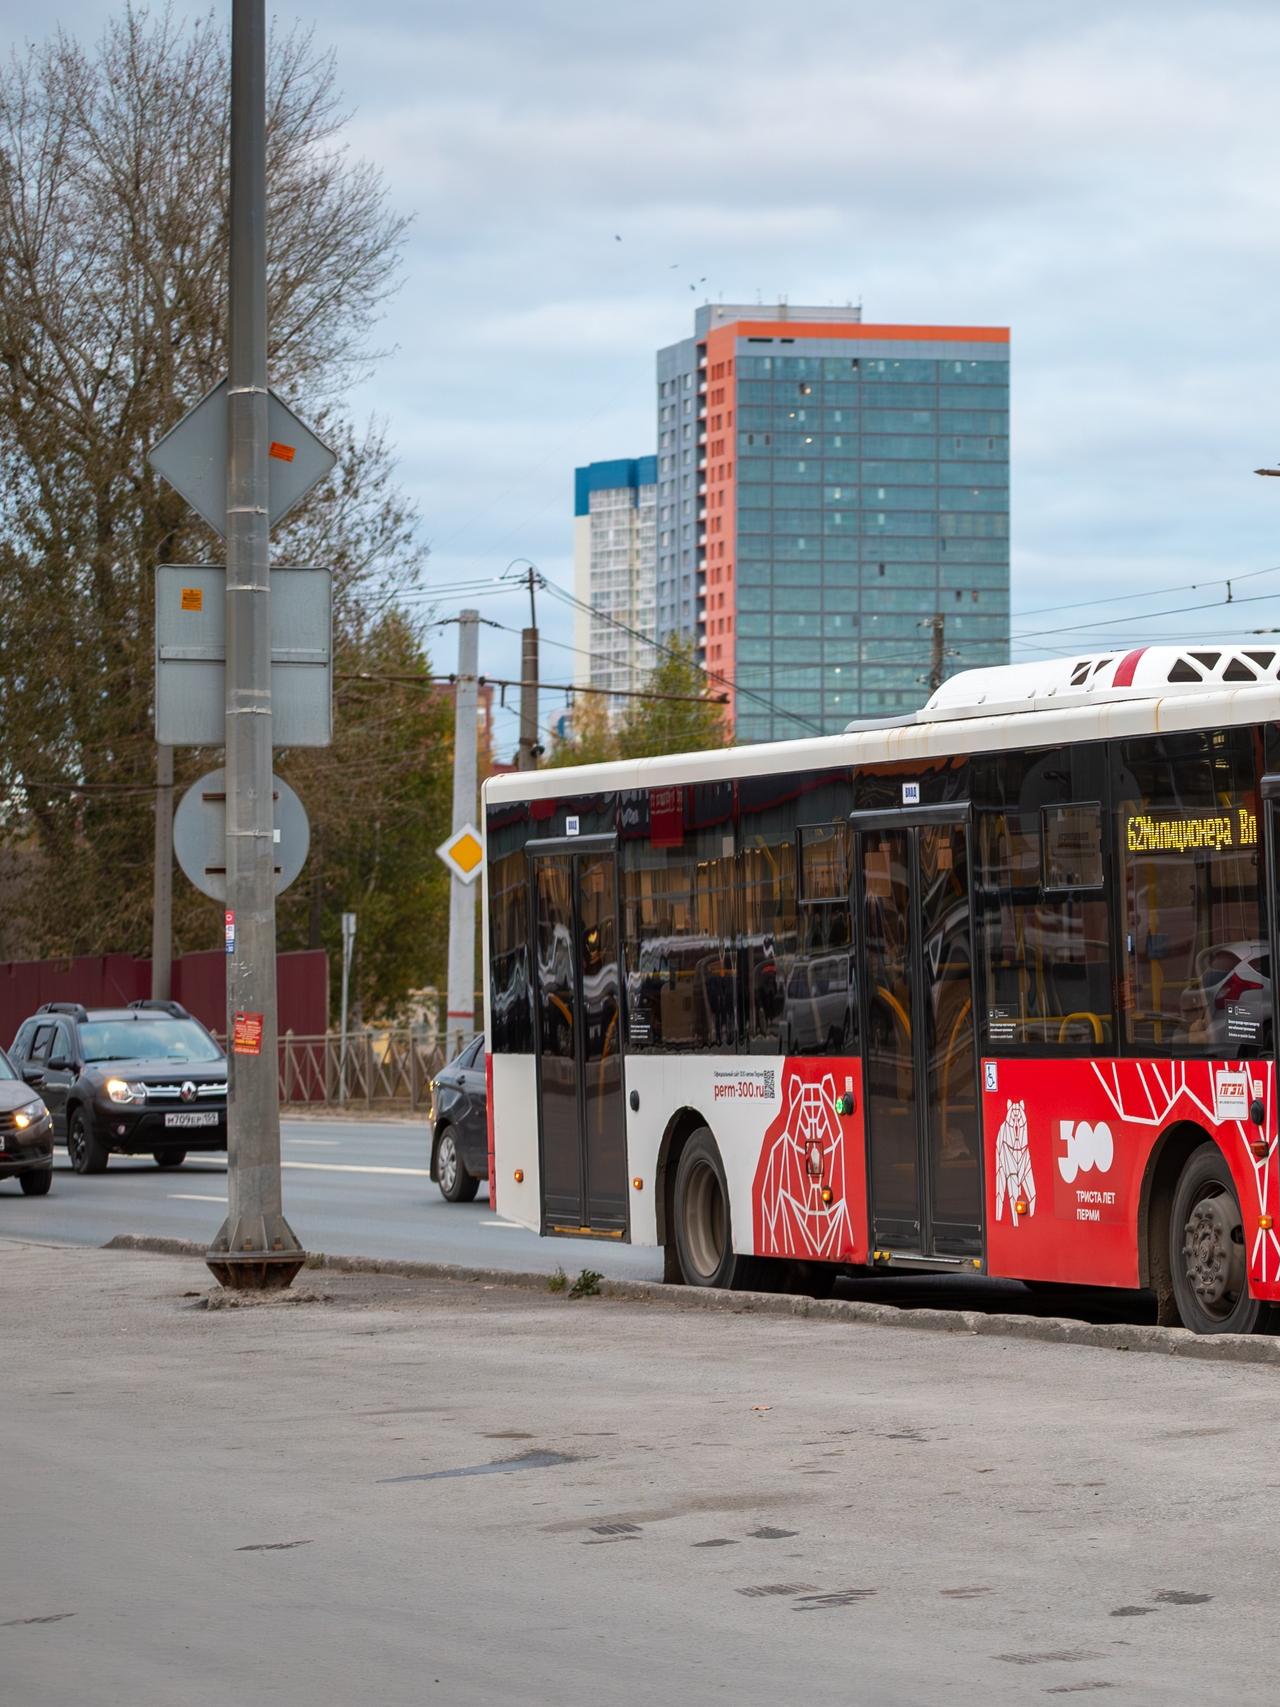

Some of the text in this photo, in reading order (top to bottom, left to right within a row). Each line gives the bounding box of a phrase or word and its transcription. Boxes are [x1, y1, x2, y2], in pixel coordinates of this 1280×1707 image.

[714, 1081, 765, 1101] perm-300.ru
[1058, 1120, 1114, 1184] 300
[1076, 1190, 1116, 1205] ТРИСТА ЛЕТ
[1076, 1208, 1100, 1222] ПЕРМИ
